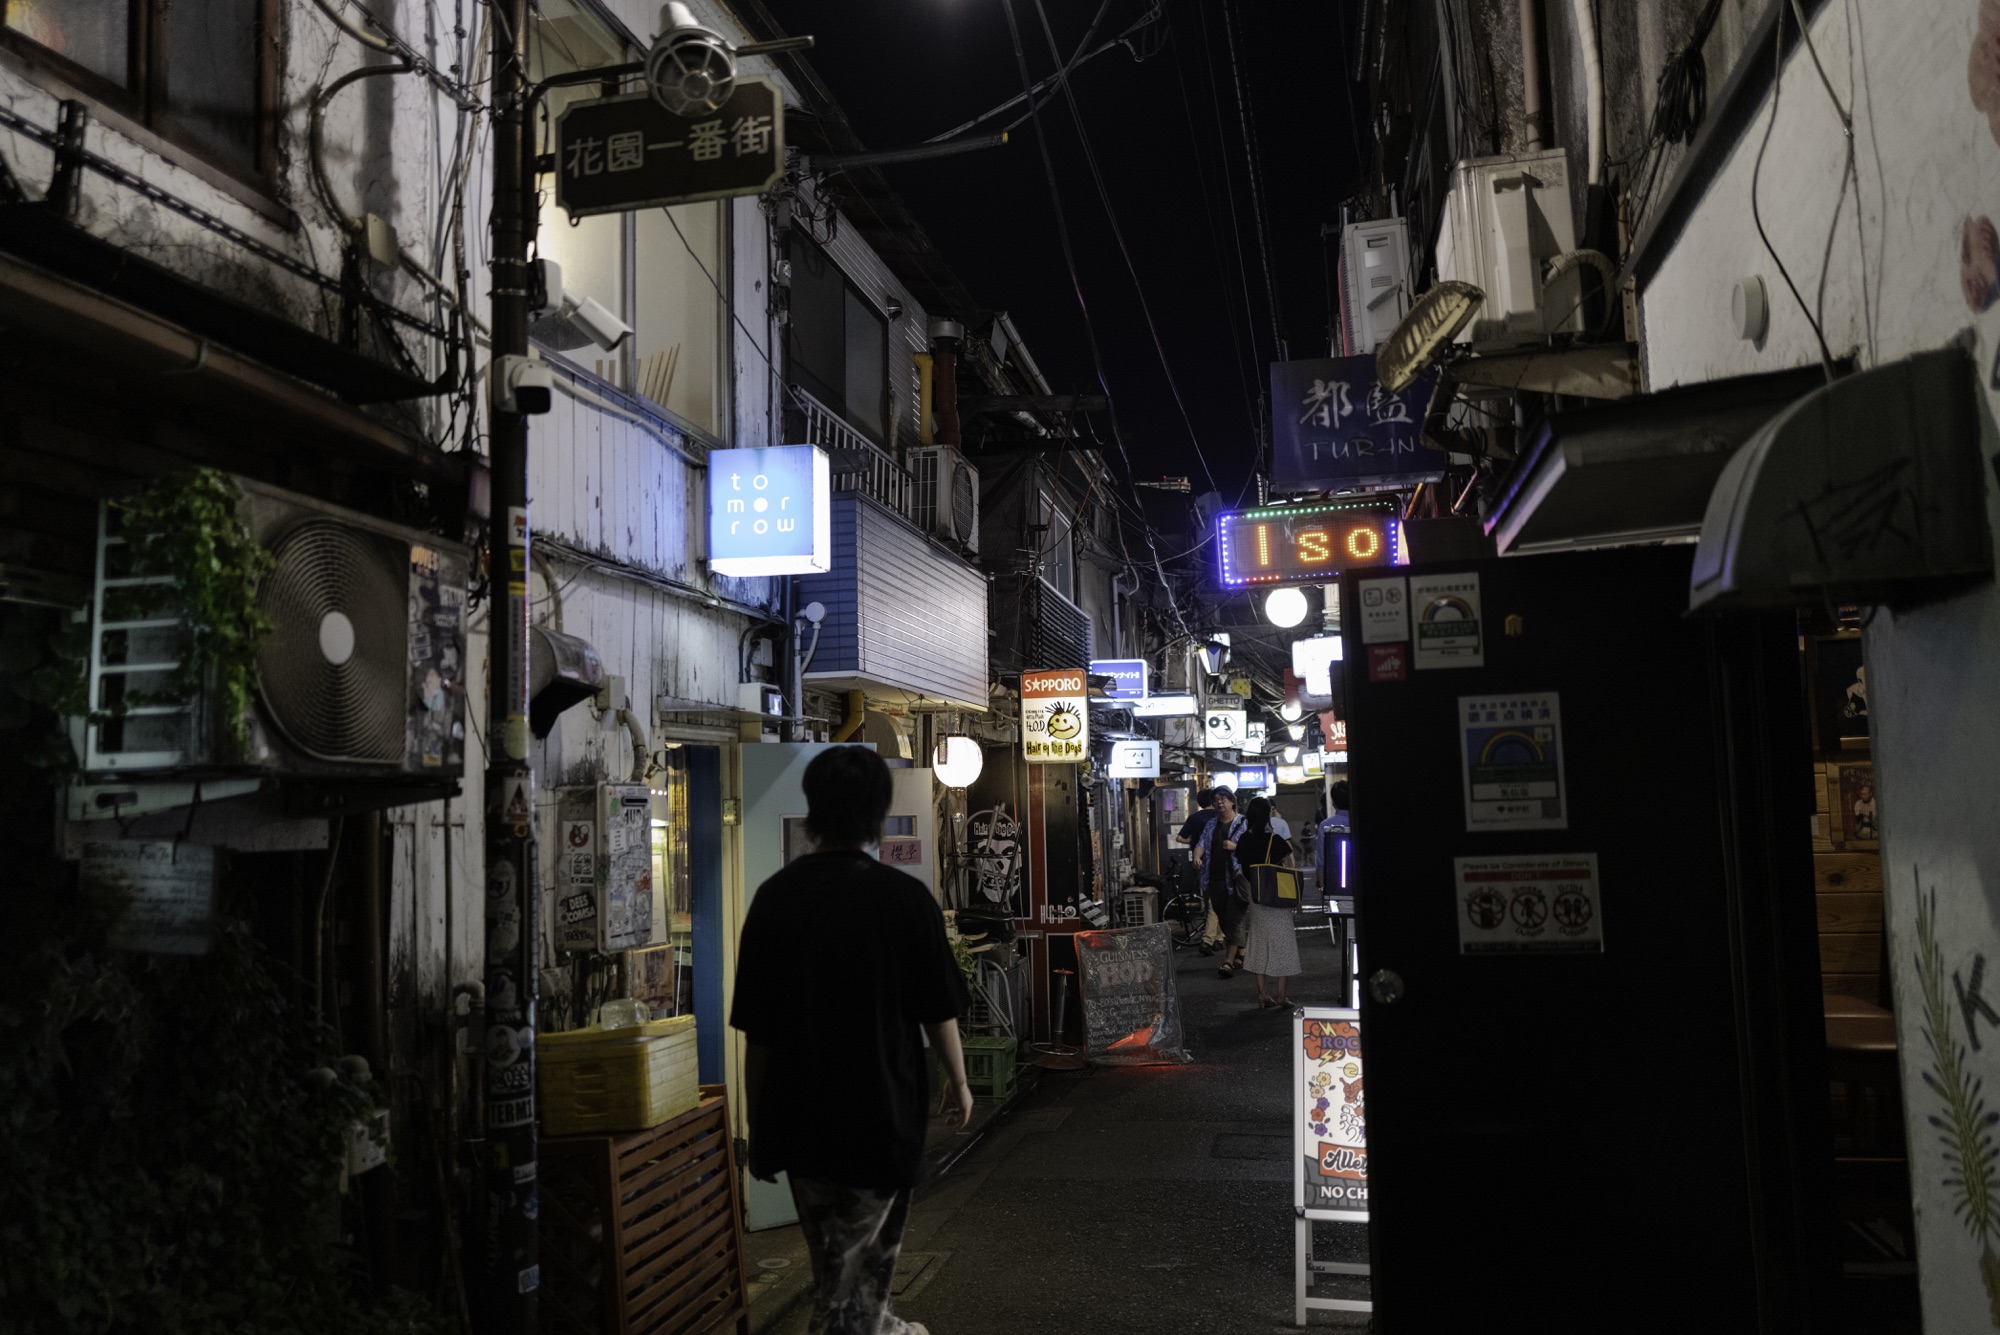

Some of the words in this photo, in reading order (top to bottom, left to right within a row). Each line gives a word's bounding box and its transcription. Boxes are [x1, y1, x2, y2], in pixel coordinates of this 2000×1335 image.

[566, 116, 773, 179] 花園一番街
[1304, 436, 1415, 461] TURAN
[1208, 697, 1240, 705] GHETTO
[1026, 741, 1041, 755] Hair
[1099, 949, 1149, 963] GUINNESS
[1321, 1186, 1344, 1198] NO
